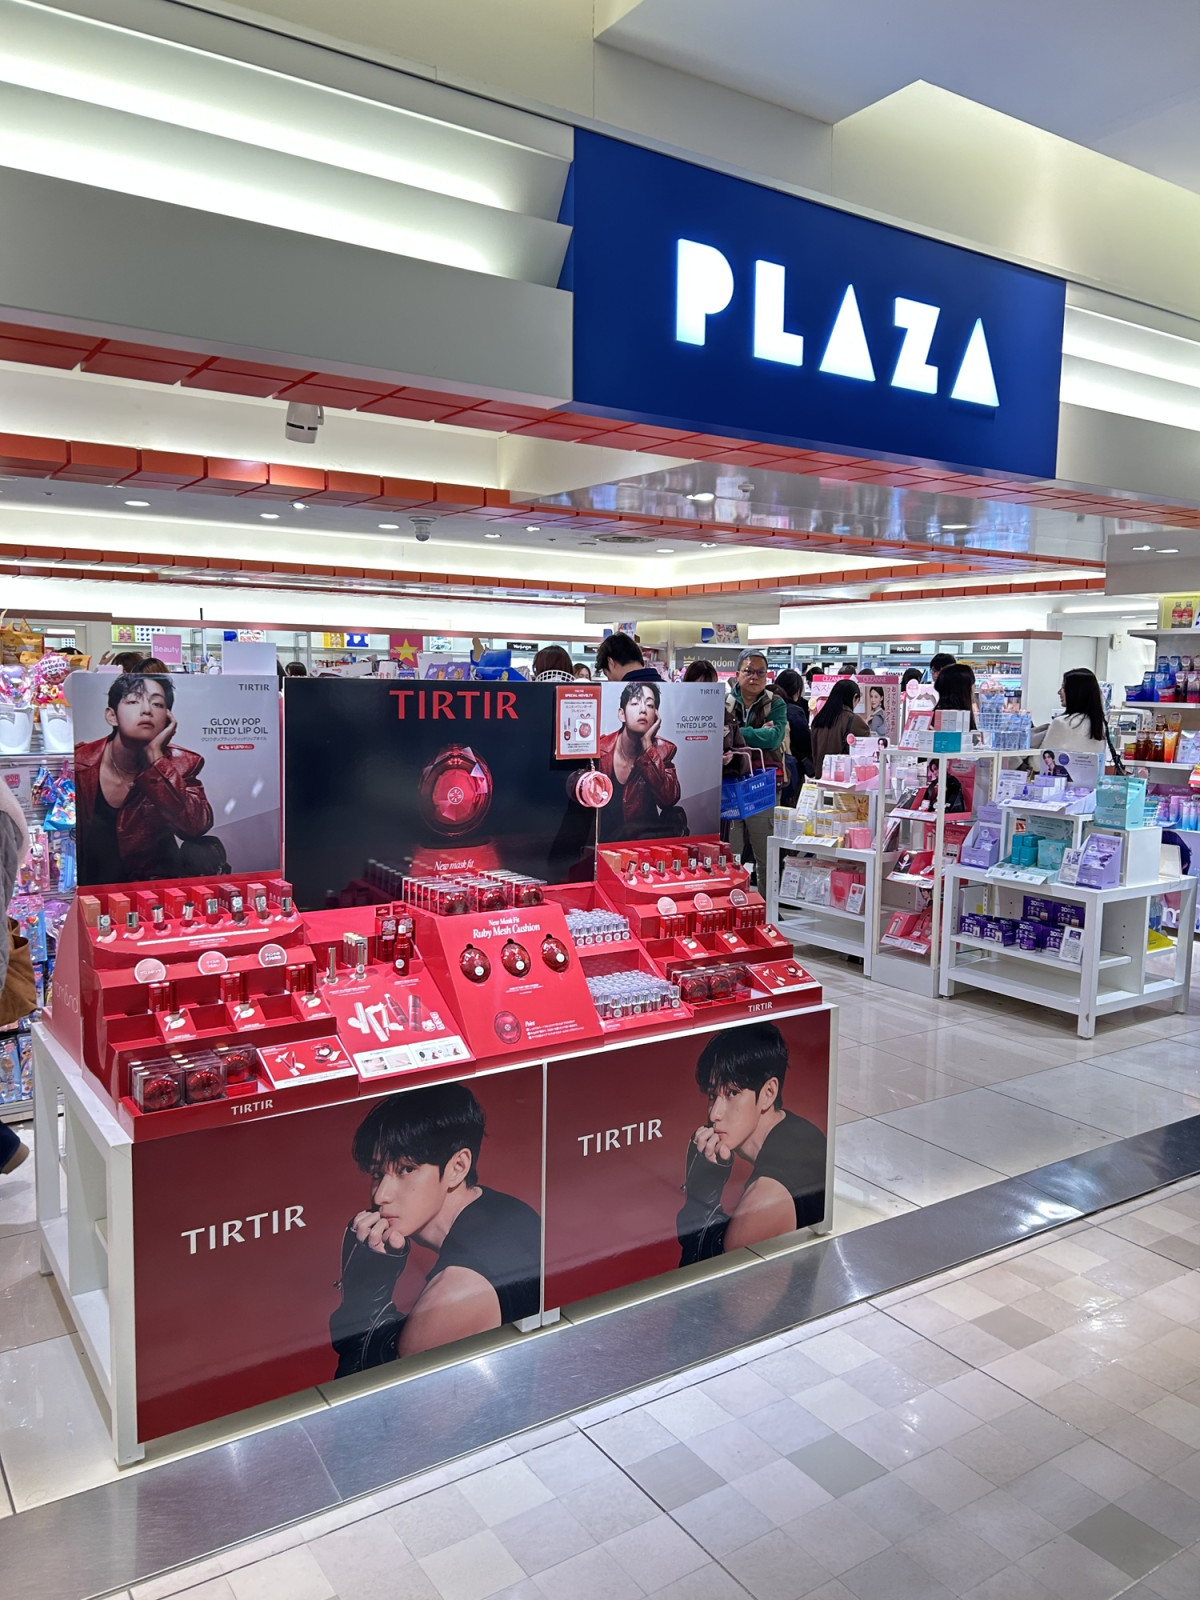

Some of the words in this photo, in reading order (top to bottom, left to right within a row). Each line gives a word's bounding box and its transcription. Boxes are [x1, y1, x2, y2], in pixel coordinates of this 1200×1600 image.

[675, 237, 1000, 408] PLAZA
[154, 645, 180, 654] Beauty
[238, 683, 270, 691] TIRTIR
[389, 690, 519, 720] TIRTIR
[210, 718, 240, 726] GLOW
[202, 727, 236, 735] TINTED
[238, 727, 251, 735] LIP
[751, 782, 765, 790] PLAZA
[433, 861, 448, 871] New
[449, 860, 465, 870] mask
[464, 858, 475, 871] fit
[473, 928, 492, 939] Ruby
[493, 926, 511, 936] Mesh
[512, 923, 541, 935] Cushion
[748, 1002, 773, 1012] TIRTIR
[231, 1099, 274, 1116] TIRTIR
[577, 1117, 663, 1157] TIRTIR
[181, 1204, 307, 1255] TIRTIR
